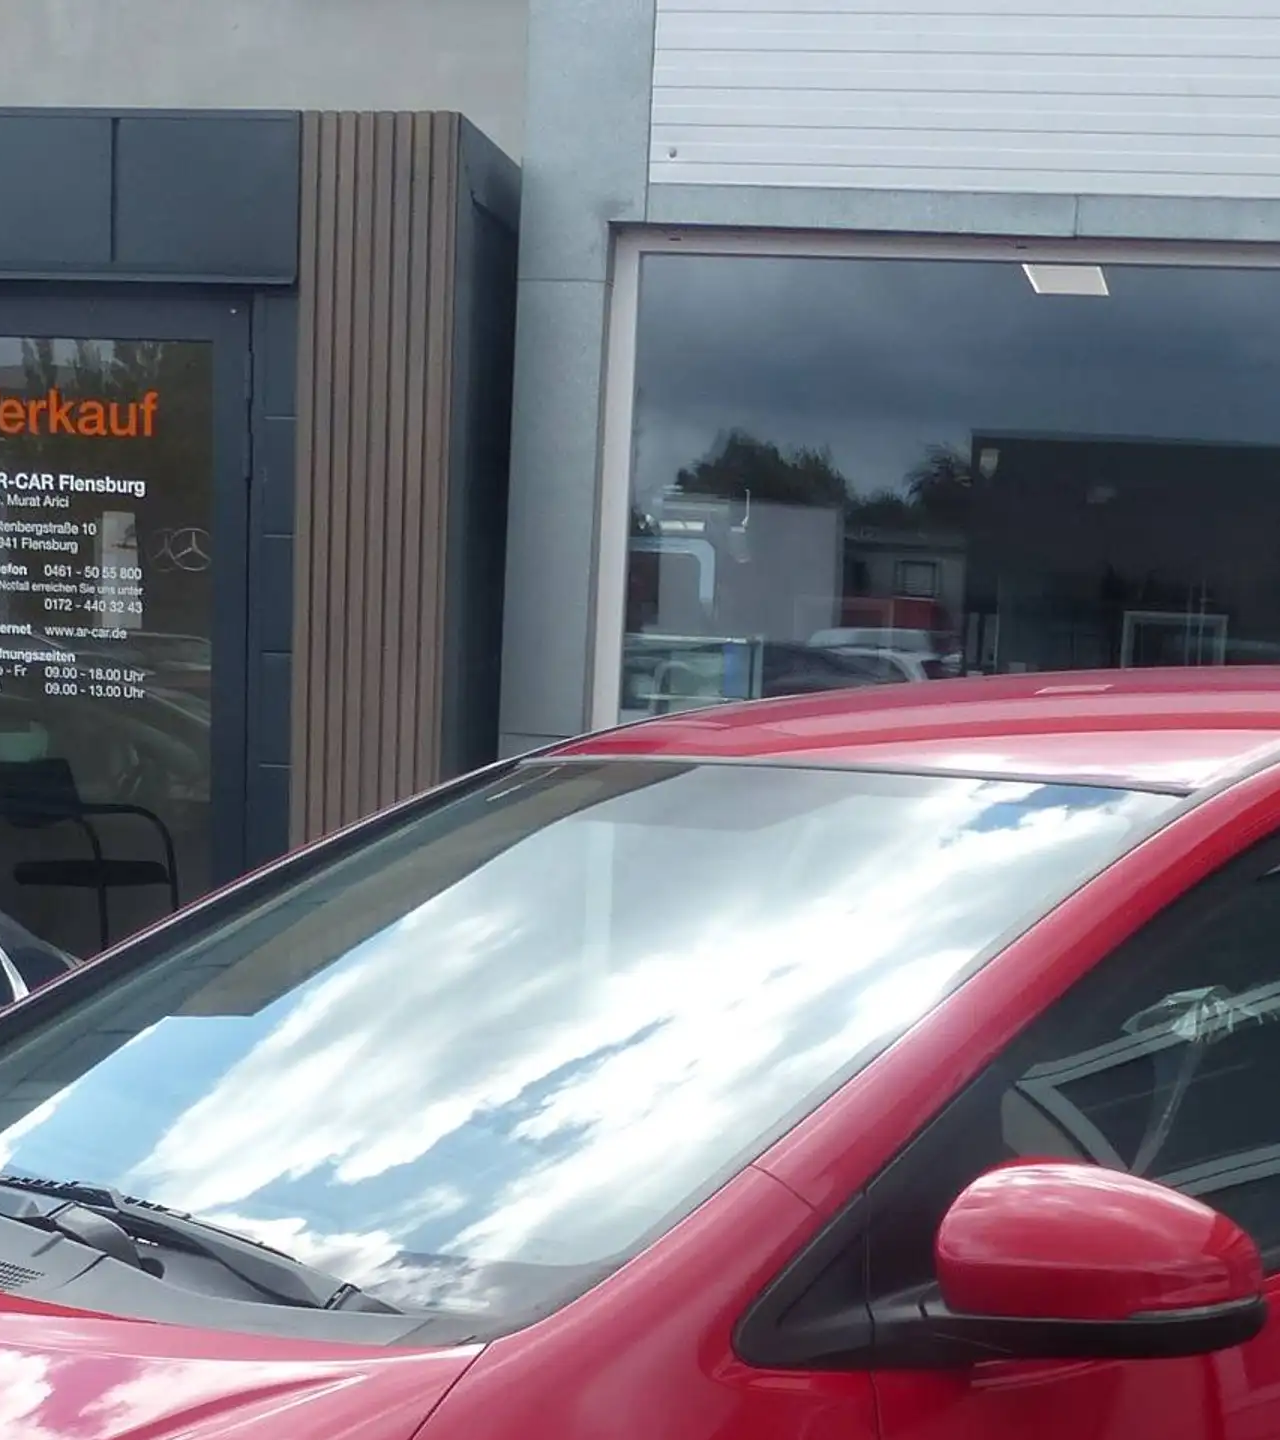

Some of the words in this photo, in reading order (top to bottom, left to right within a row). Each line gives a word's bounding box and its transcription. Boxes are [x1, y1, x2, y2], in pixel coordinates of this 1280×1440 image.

[59, 474, 146, 497] Flensburg
[7, 494, 40, 507] Murat
[43, 495, 69, 507] Arici
[82, 523, 97, 535] 10
[21, 538, 78, 554] Flensburg
[44, 564, 72, 577] 0461
[84, 566, 99, 579] 50
[102, 567, 117, 579] 55
[120, 567, 142, 580] 800
[31, 582, 77, 593] erreichen
[79, 583, 95, 594] Sie
[44, 598, 73, 612] 0172
[83, 600, 106, 613] 440
[110, 601, 124, 614] 32
[127, 602, 143, 615] 43
[44, 626, 128, 640] www.ar-car.de
[14, 664, 27, 677] Fr
[44, 666, 77, 679] 09.00
[89, 668, 121, 681] 18.00
[123, 670, 146, 682] Uhr
[44, 682, 77, 695] 09.00
[89, 685, 121, 698] 13.00
[123, 686, 146, 699] Uhr
